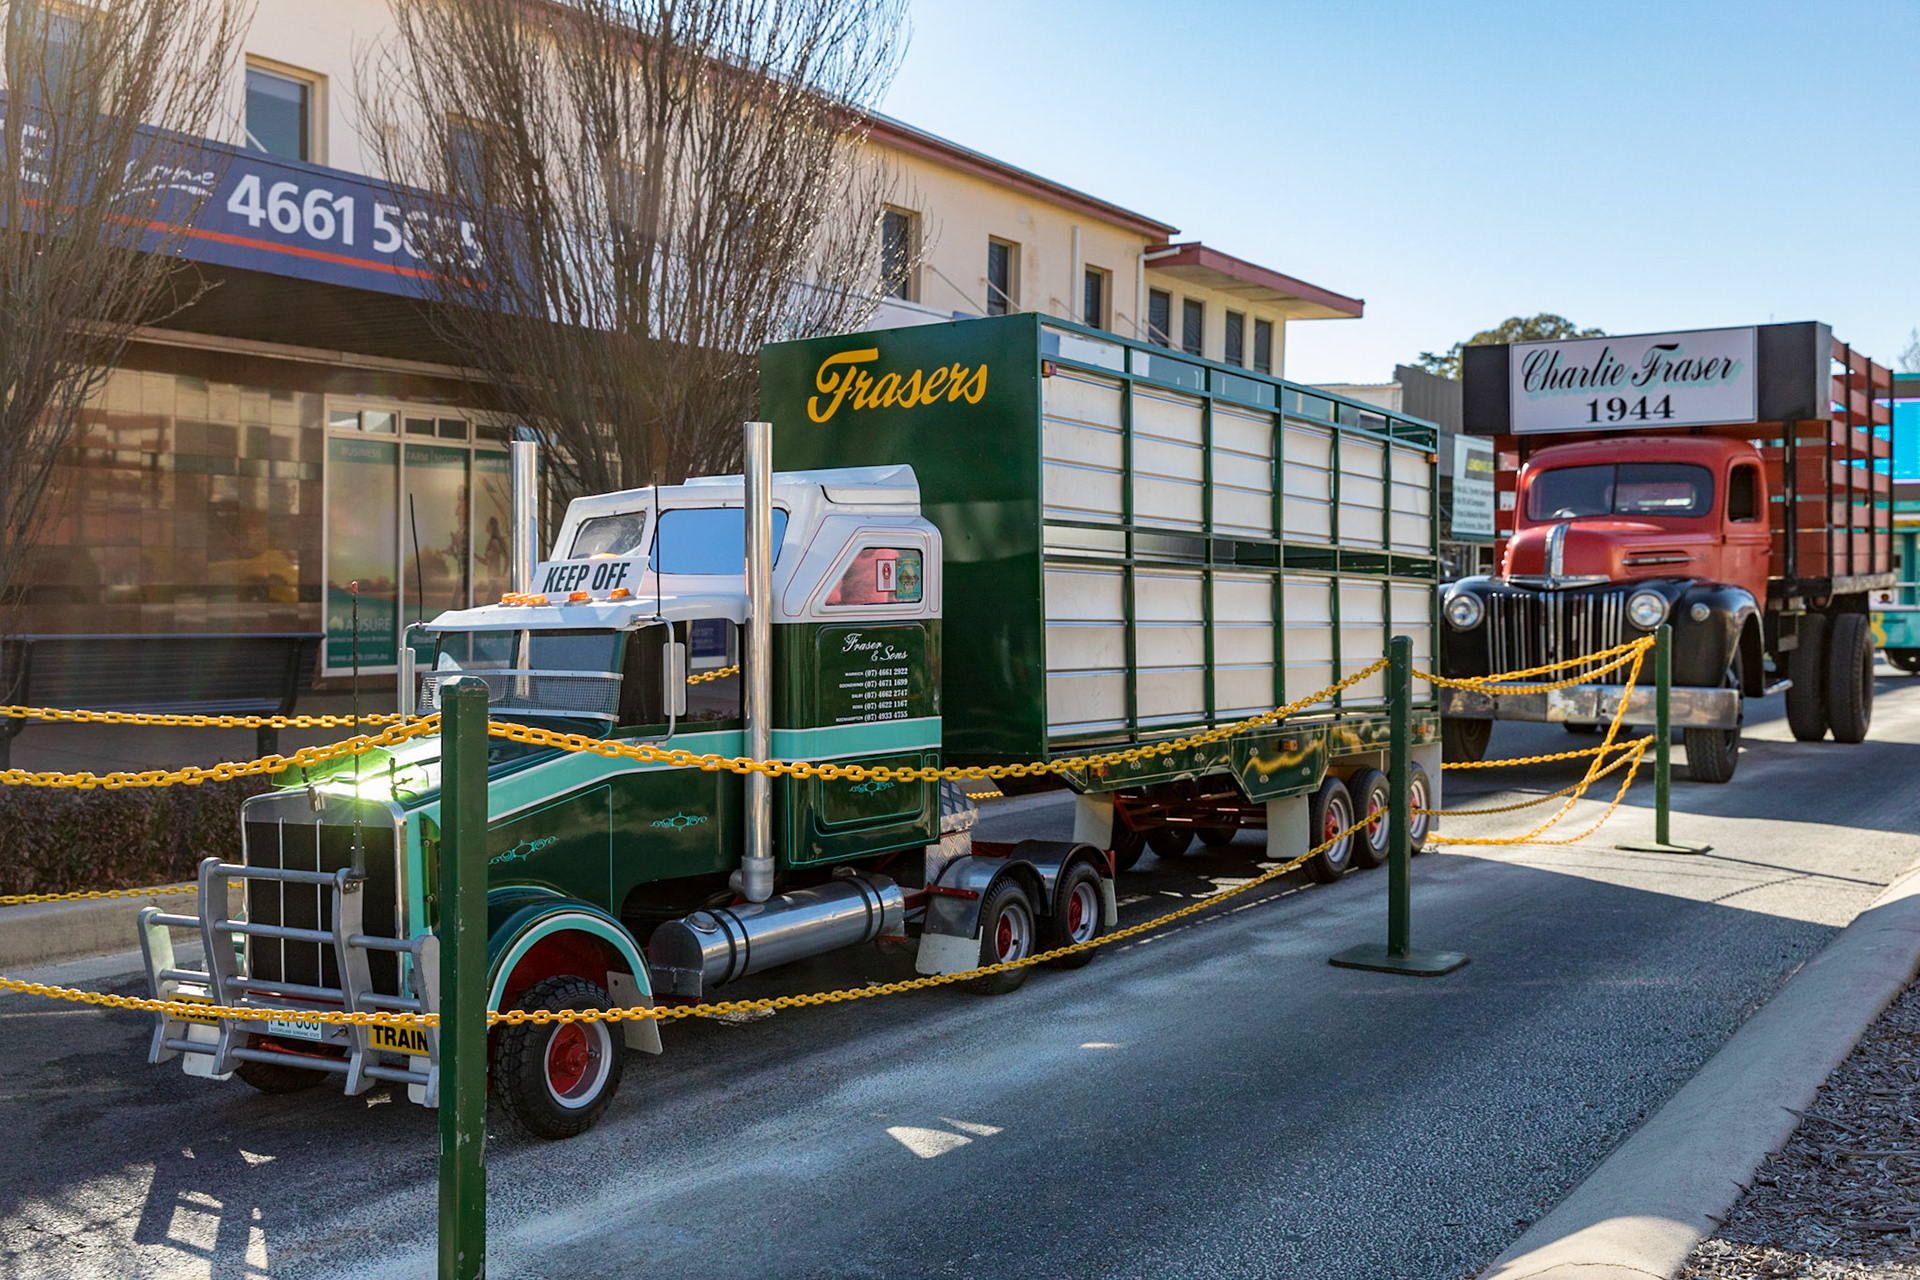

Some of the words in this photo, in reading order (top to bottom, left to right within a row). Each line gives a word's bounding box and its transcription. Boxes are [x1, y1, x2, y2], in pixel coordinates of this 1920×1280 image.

[227, 173, 354, 246] 4661
[1521, 346, 1627, 393] Charlie
[1631, 343, 1732, 388] Fraser
[807, 347, 988, 424] Frasers
[1585, 394, 1675, 424] 1944
[542, 564, 590, 593] KEEP
[591, 562, 631, 591] OFF
[842, 632, 883, 652] Fraser
[870, 649, 879, 661] &
[880, 645, 908, 661] Sons
[864, 669, 878, 678] (07)
[864, 680, 878, 689] (07)
[864, 691, 877, 700] (07)
[864, 702, 877, 711] (07)
[864, 713, 877, 722] (07)
[372, 1024, 429, 1051] TRAIN
